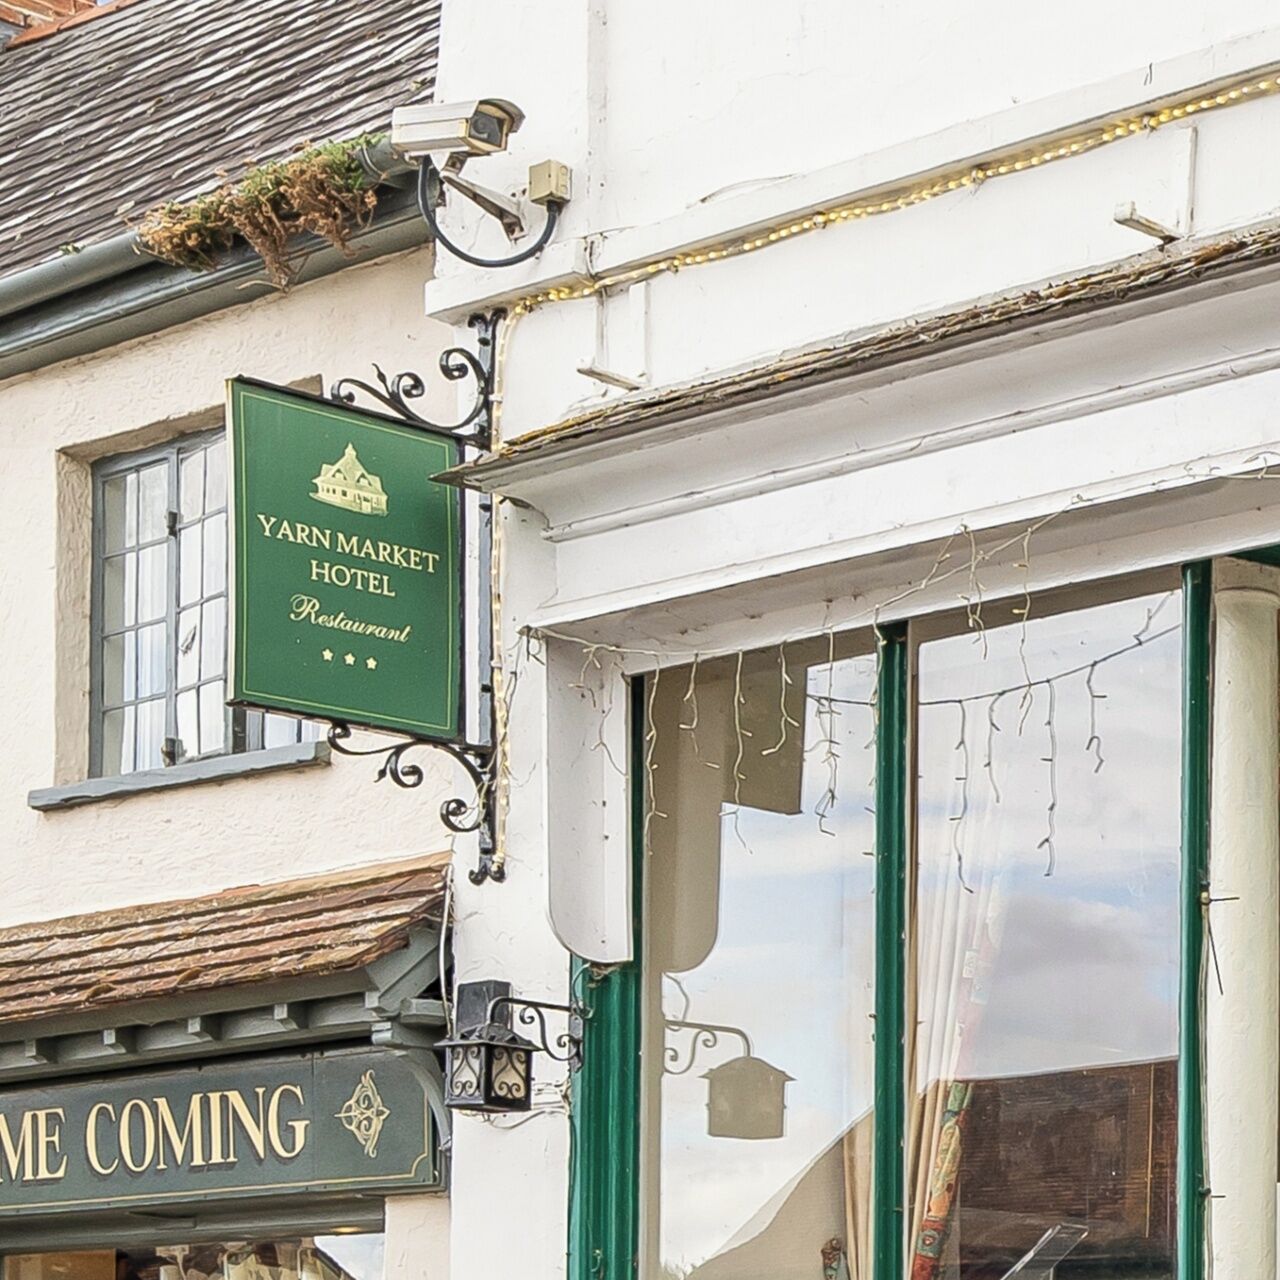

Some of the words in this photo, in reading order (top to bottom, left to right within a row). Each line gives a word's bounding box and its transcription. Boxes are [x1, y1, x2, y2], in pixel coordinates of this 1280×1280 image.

[257, 513, 331, 549] YARN
[336, 532, 440, 573] MARKET
[310, 560, 396, 597] HOTEL
[289, 594, 412, 643] Restaurant
[85, 1084, 311, 1175] COMING
